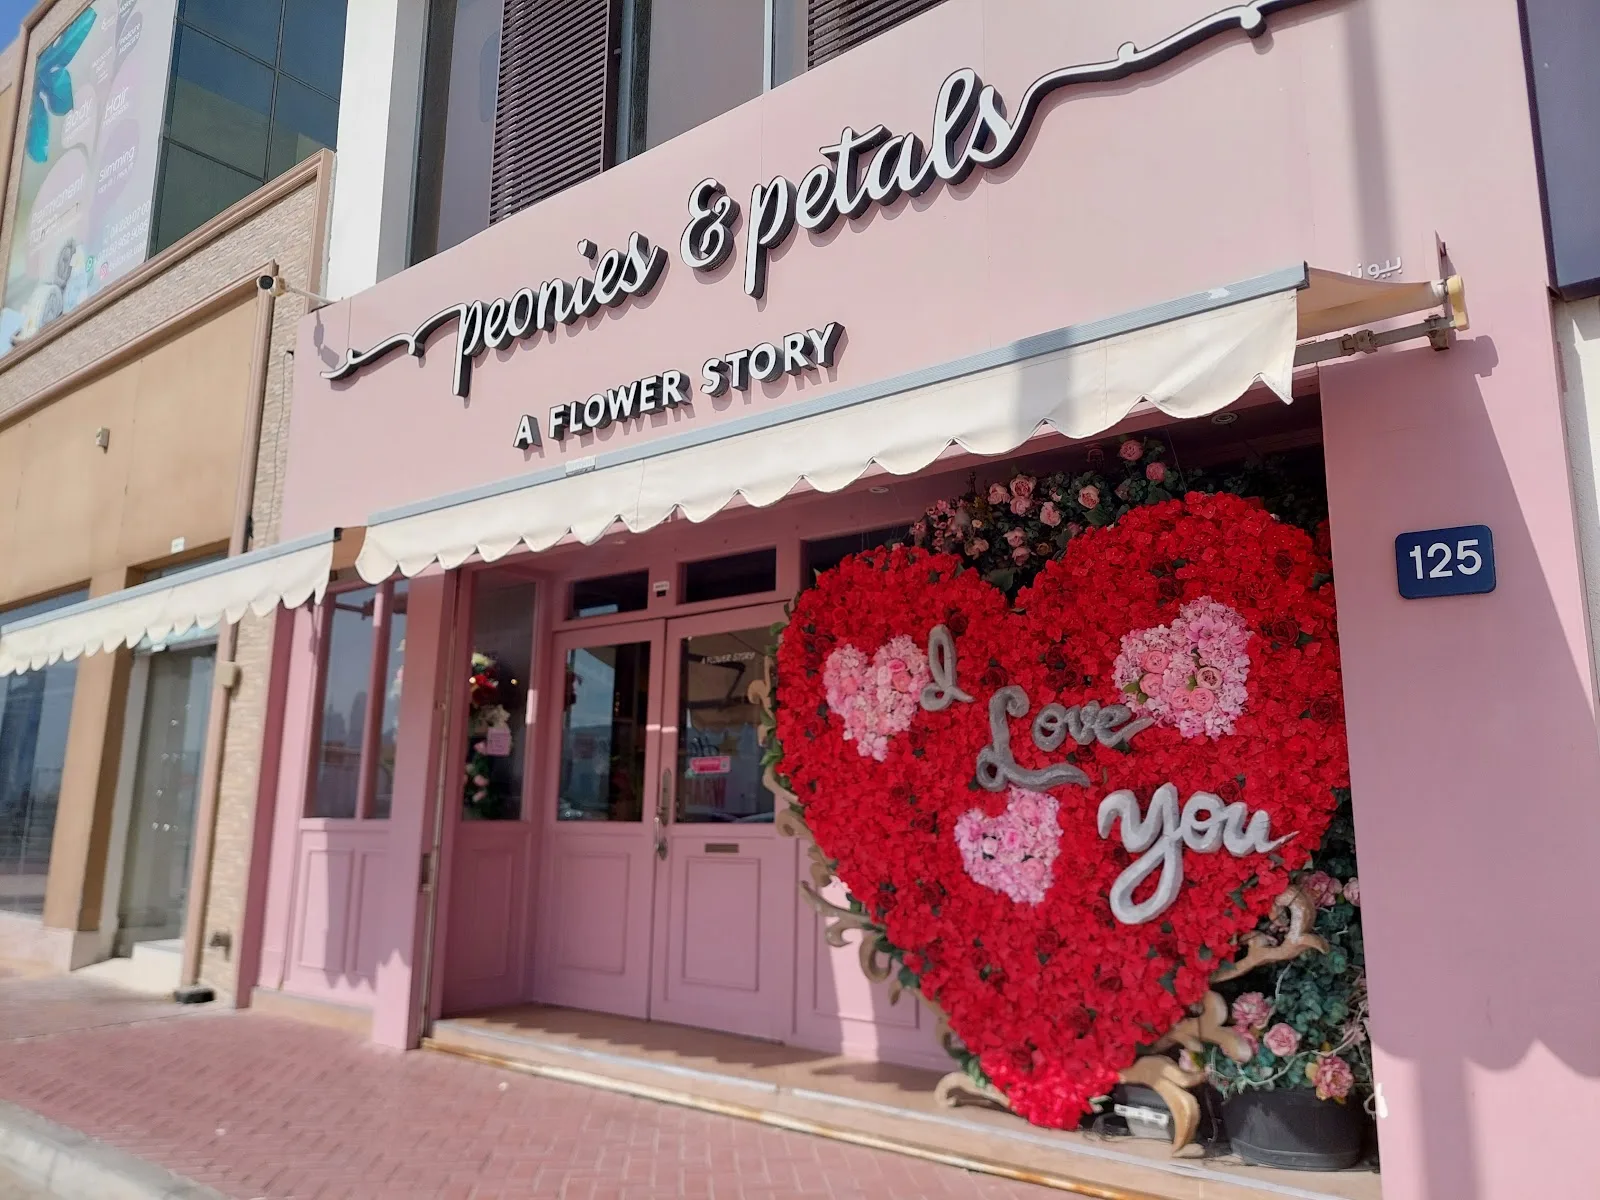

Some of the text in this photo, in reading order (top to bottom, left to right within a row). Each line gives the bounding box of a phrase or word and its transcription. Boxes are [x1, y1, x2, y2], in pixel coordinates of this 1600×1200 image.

[64, 97, 93, 133] Body
[104, 86, 128, 120] Hair
[98, 145, 136, 182] Slimming
[31, 173, 85, 224] Permanent
[452, 67, 1020, 398] peonies & petals
[513, 321, 845, 450] A FLOWER STORY
[1409, 538, 1483, 580] 125
[920, 623, 976, 712] I
[975, 685, 1155, 793] Love
